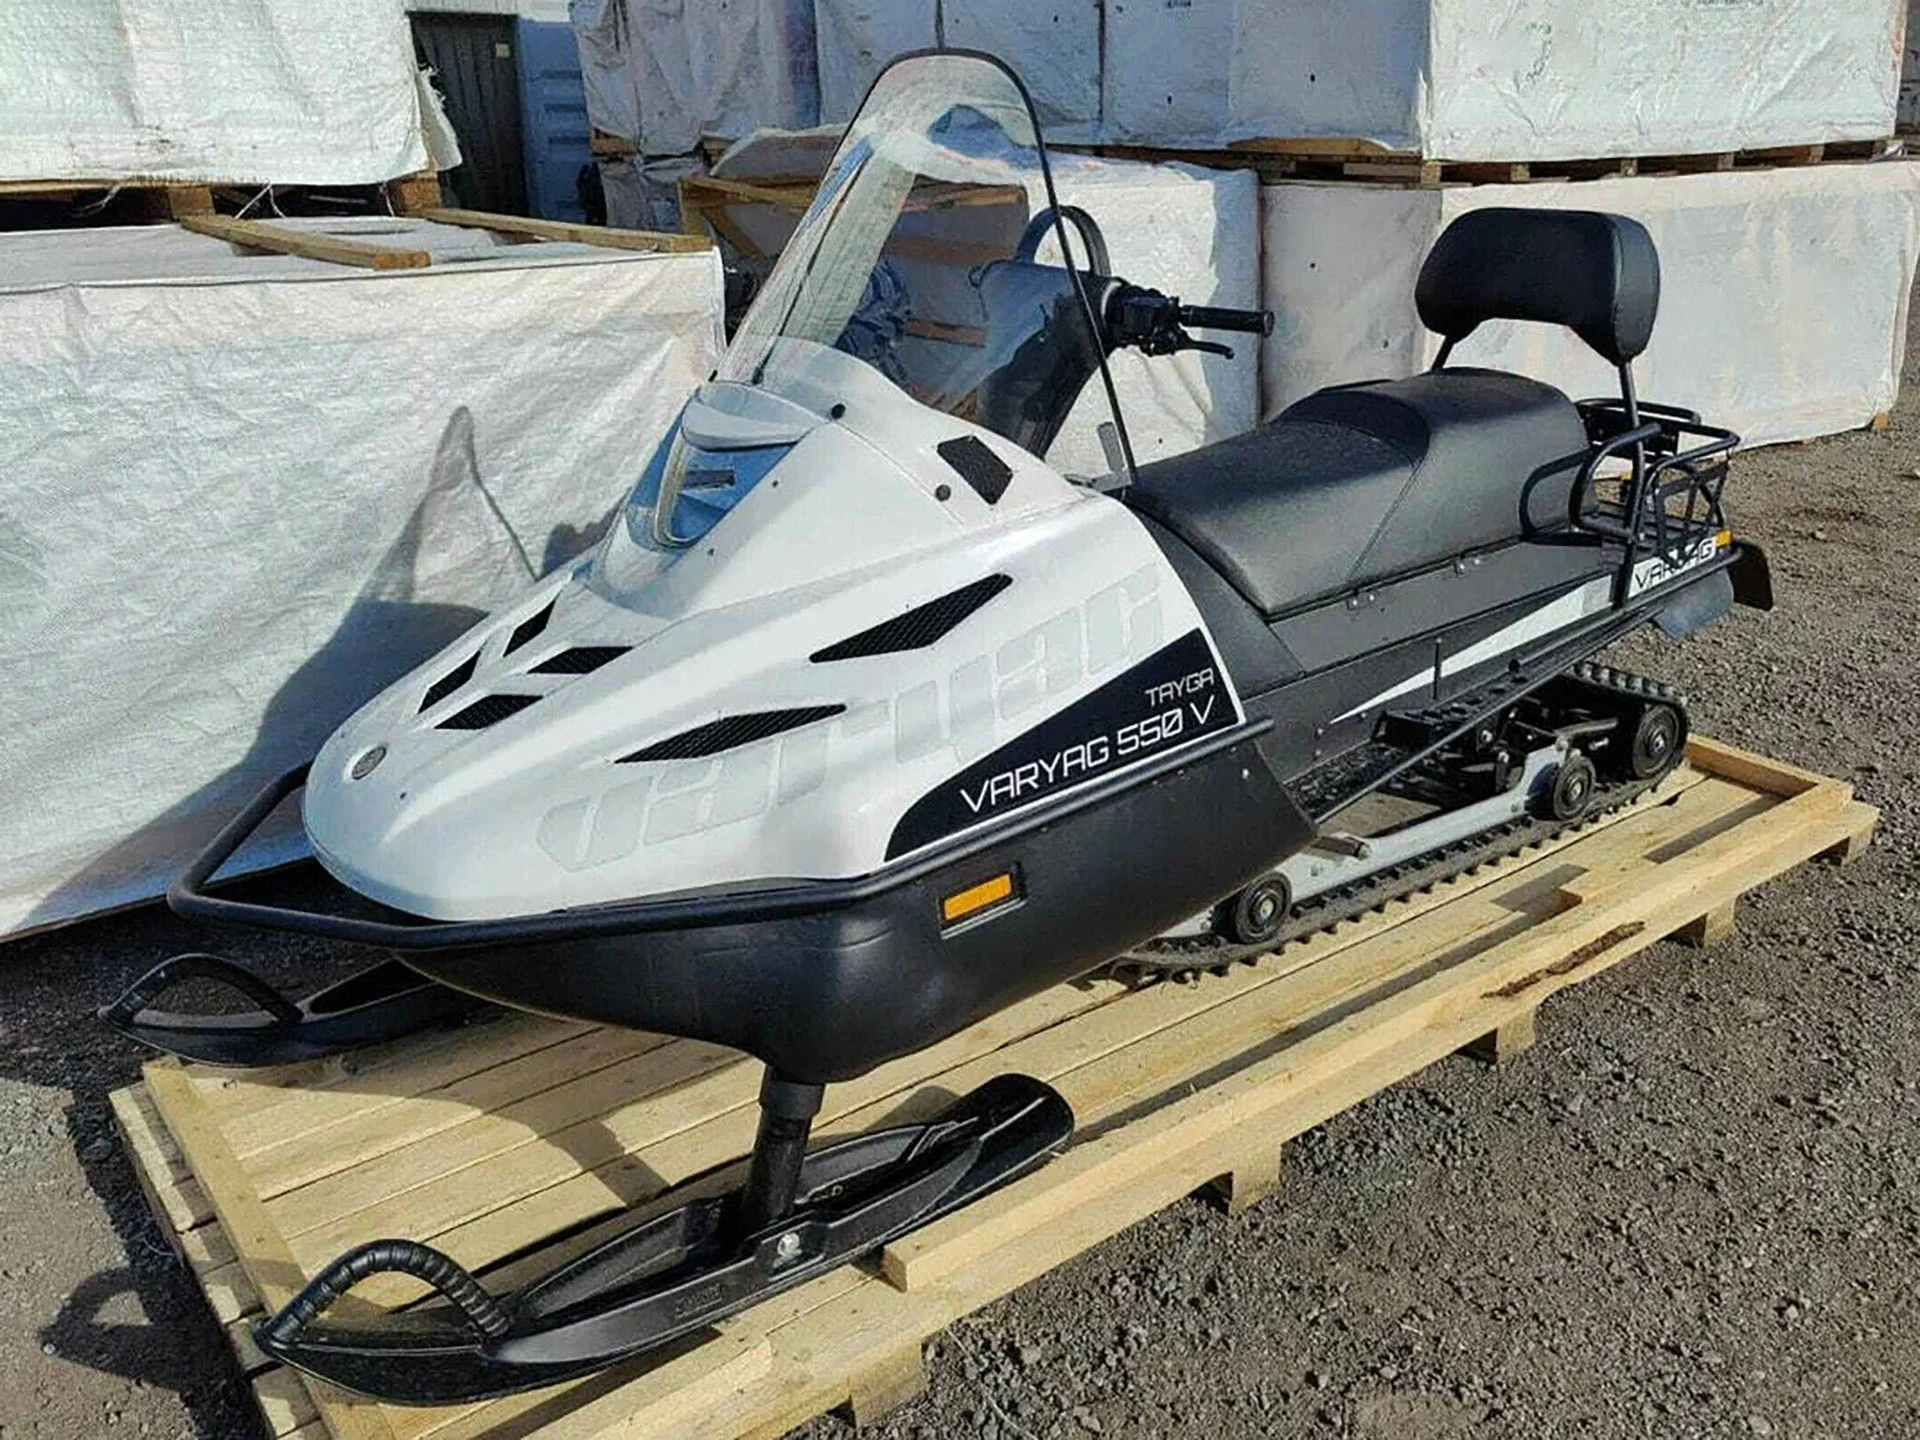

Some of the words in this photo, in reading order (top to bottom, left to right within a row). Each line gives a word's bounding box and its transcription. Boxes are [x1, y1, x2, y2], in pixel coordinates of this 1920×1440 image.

[1145, 667, 1214, 706] TAYGA
[960, 736, 1109, 812] VARYAG
[1117, 707, 1183, 755] 550
[1190, 695, 1214, 724] V
